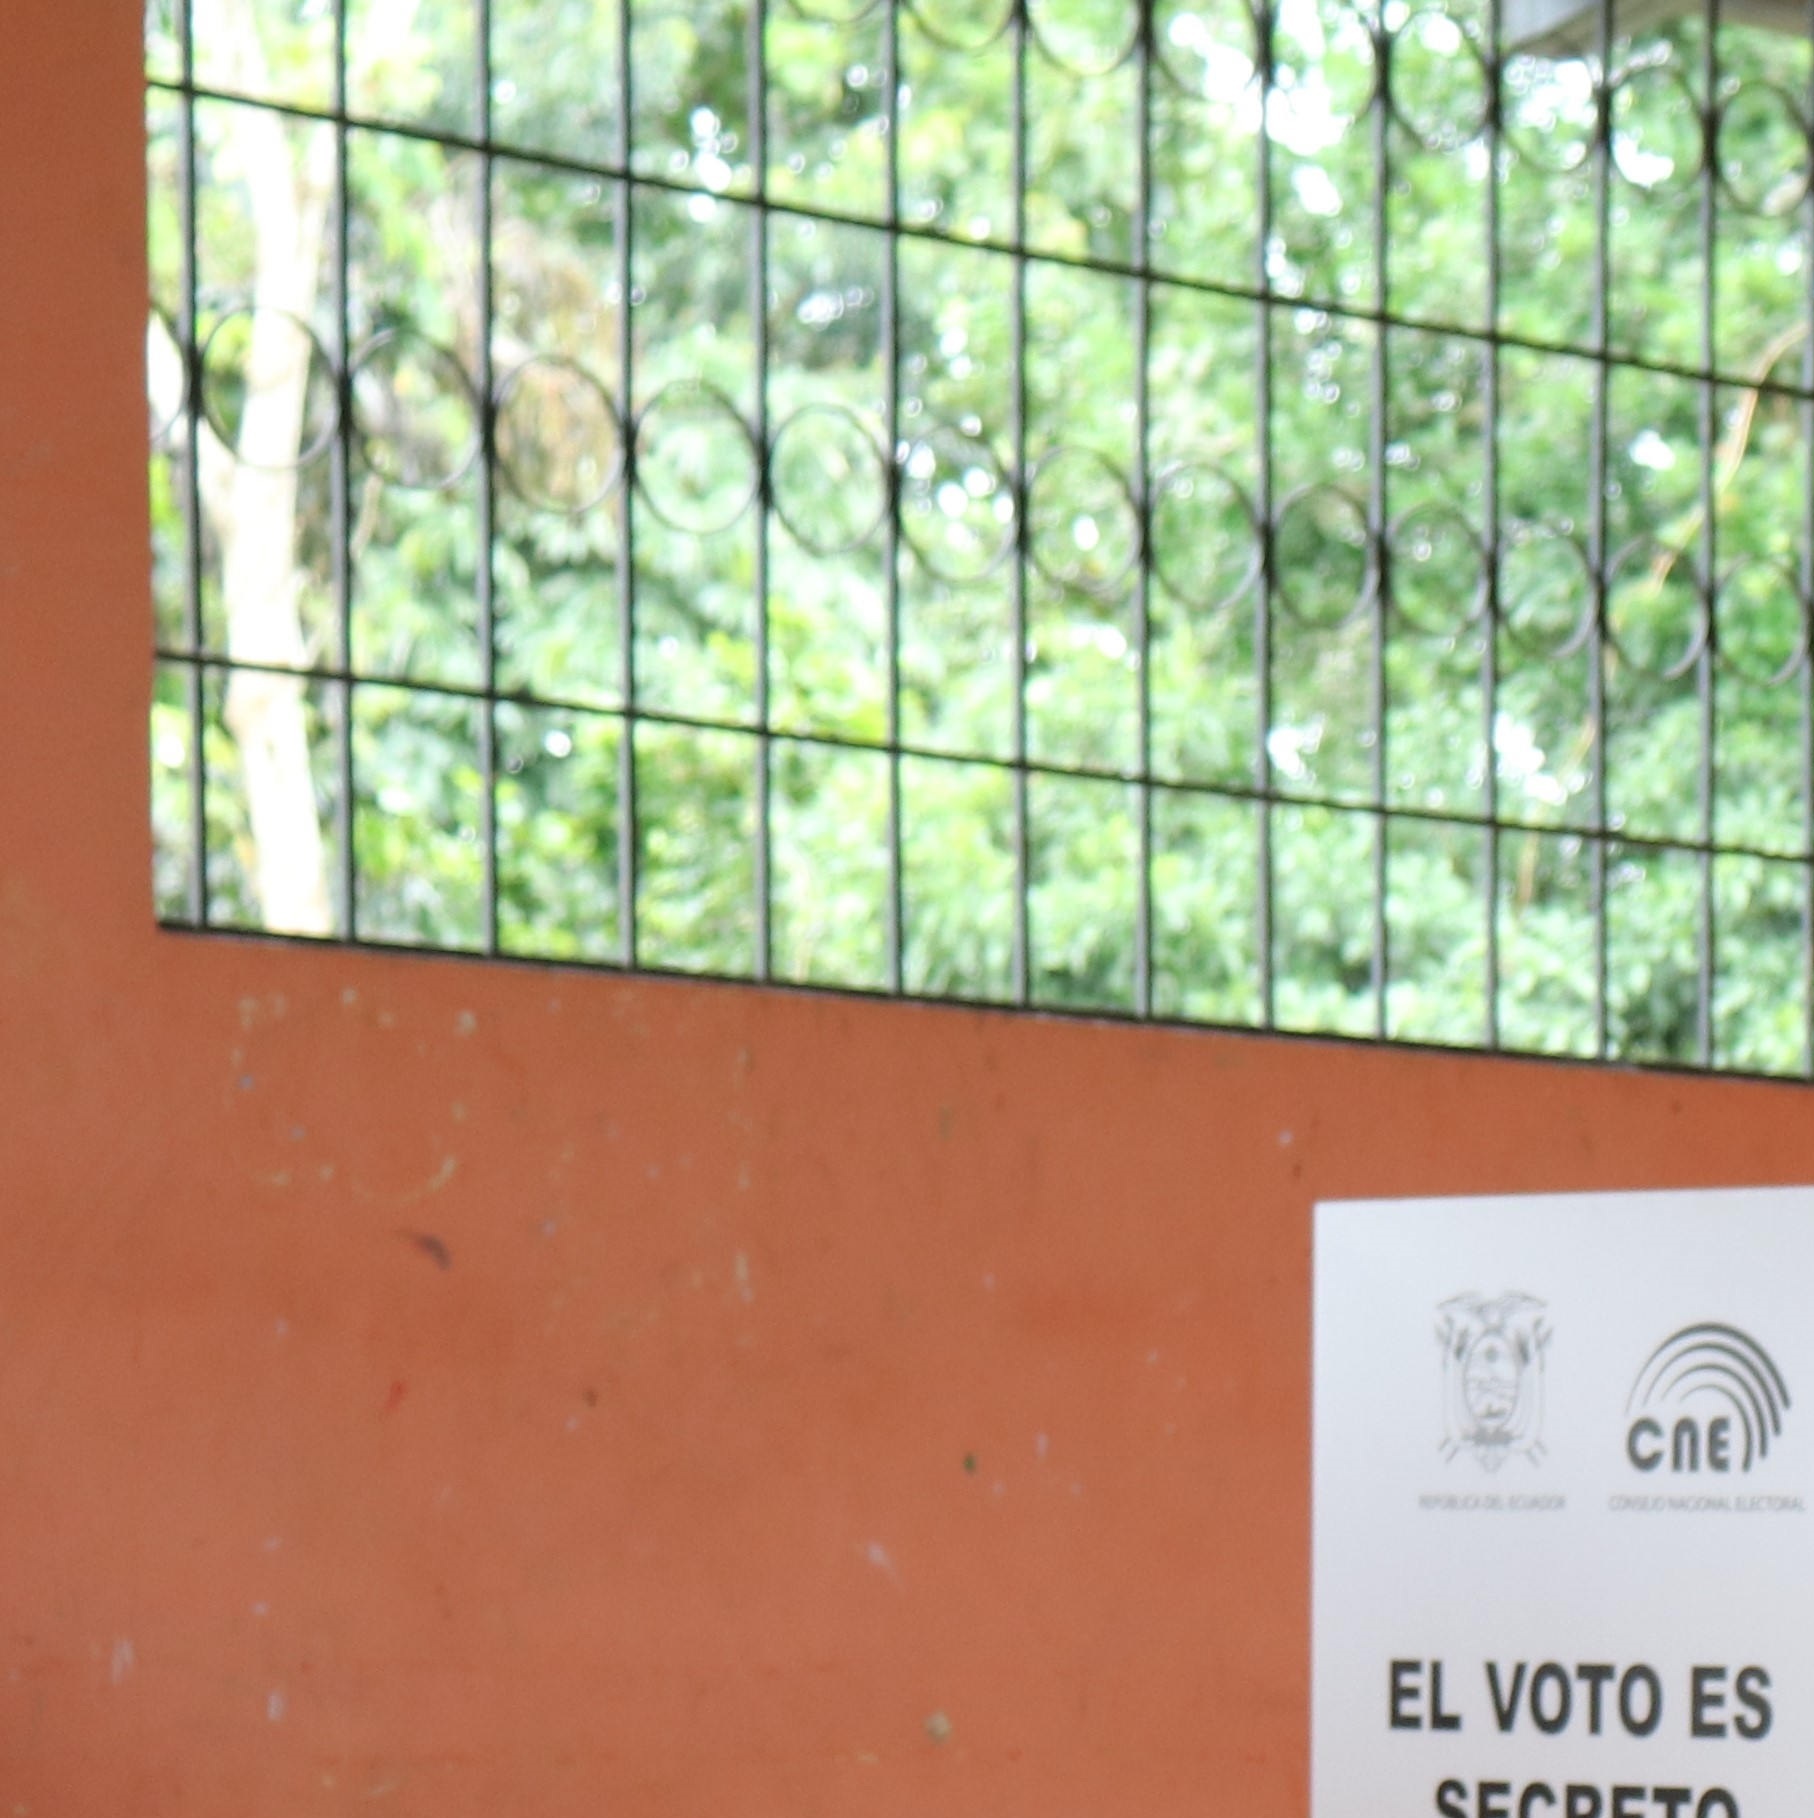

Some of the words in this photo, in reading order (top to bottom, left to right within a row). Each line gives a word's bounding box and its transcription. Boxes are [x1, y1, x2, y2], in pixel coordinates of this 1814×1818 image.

[1389, 1659, 1462, 1732] EL
[1485, 1661, 1662, 1738] VOTO
[1690, 1666, 1772, 1740] ES
